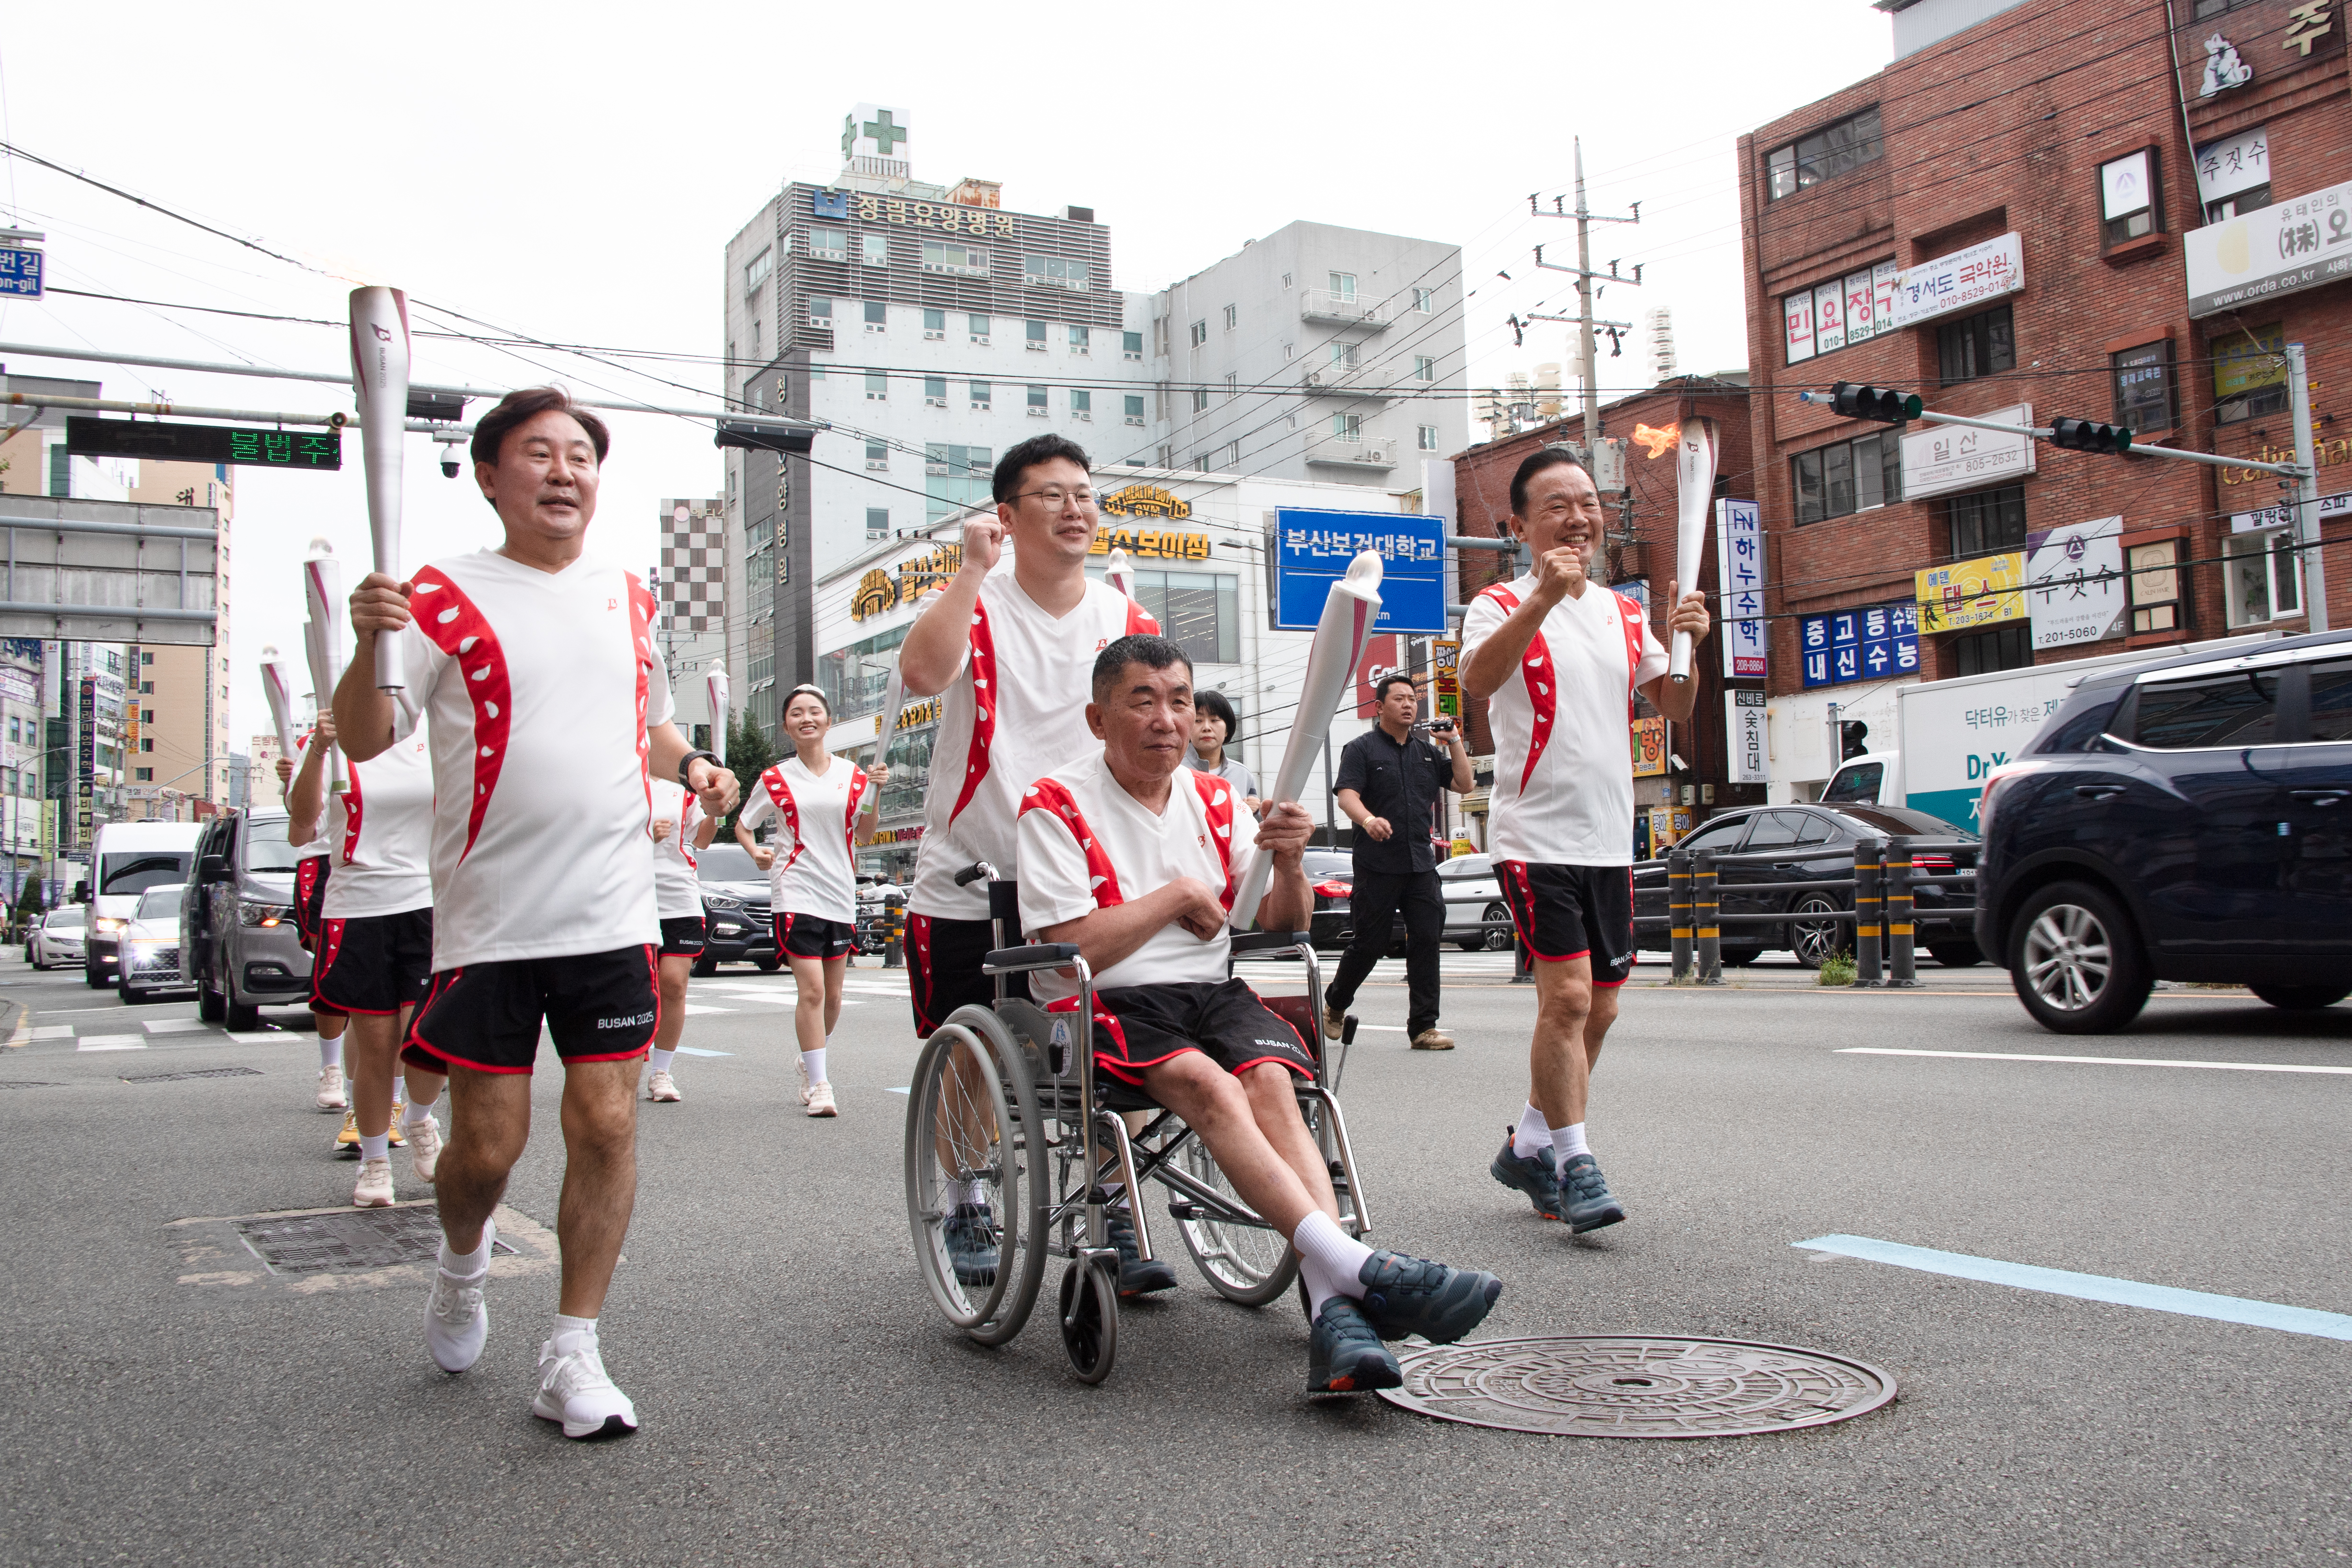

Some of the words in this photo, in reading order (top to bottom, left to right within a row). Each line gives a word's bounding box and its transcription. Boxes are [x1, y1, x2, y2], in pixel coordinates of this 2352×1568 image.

[2203, 141, 2266, 181] 주짓수
[857, 195, 1014, 239] 청림요양병원
[1906, 273, 1954, 303] 경서도
[1960, 252, 2008, 284] 국악원
[2213, 269, 2315, 307] www.orda.co.kr
[1940, 276, 2011, 308] 010-8529-0147
[1966, 450, 2017, 472] 805-2632
[1125, 485, 1154, 500] HEALTH
[1155, 487, 1171, 504] BOY
[2320, 497, 2347, 511] 스파
[1135, 504, 1160, 518] GYM
[1286, 529, 1436, 562] 부산보건대학교
[1735, 537, 1759, 647] 하누수학
[2004, 607, 2012, 616] B1
[2038, 626, 2097, 644] T.201-5060
[2111, 621, 2125, 632] 4F
[1736, 659, 1764, 671] 208-8864
[1808, 642, 1917, 681] 내신수능
[1737, 692, 1764, 705] 신비로
[1966, 706, 2017, 730] 닥터유가
[2020, 707, 2040, 723] 찾은
[1745, 709, 1760, 772] 숯침대
[598, 1015, 636, 1029] BUSAN
[637, 1011, 654, 1025] 2025
[1255, 1039, 1290, 1048] BUSAN
